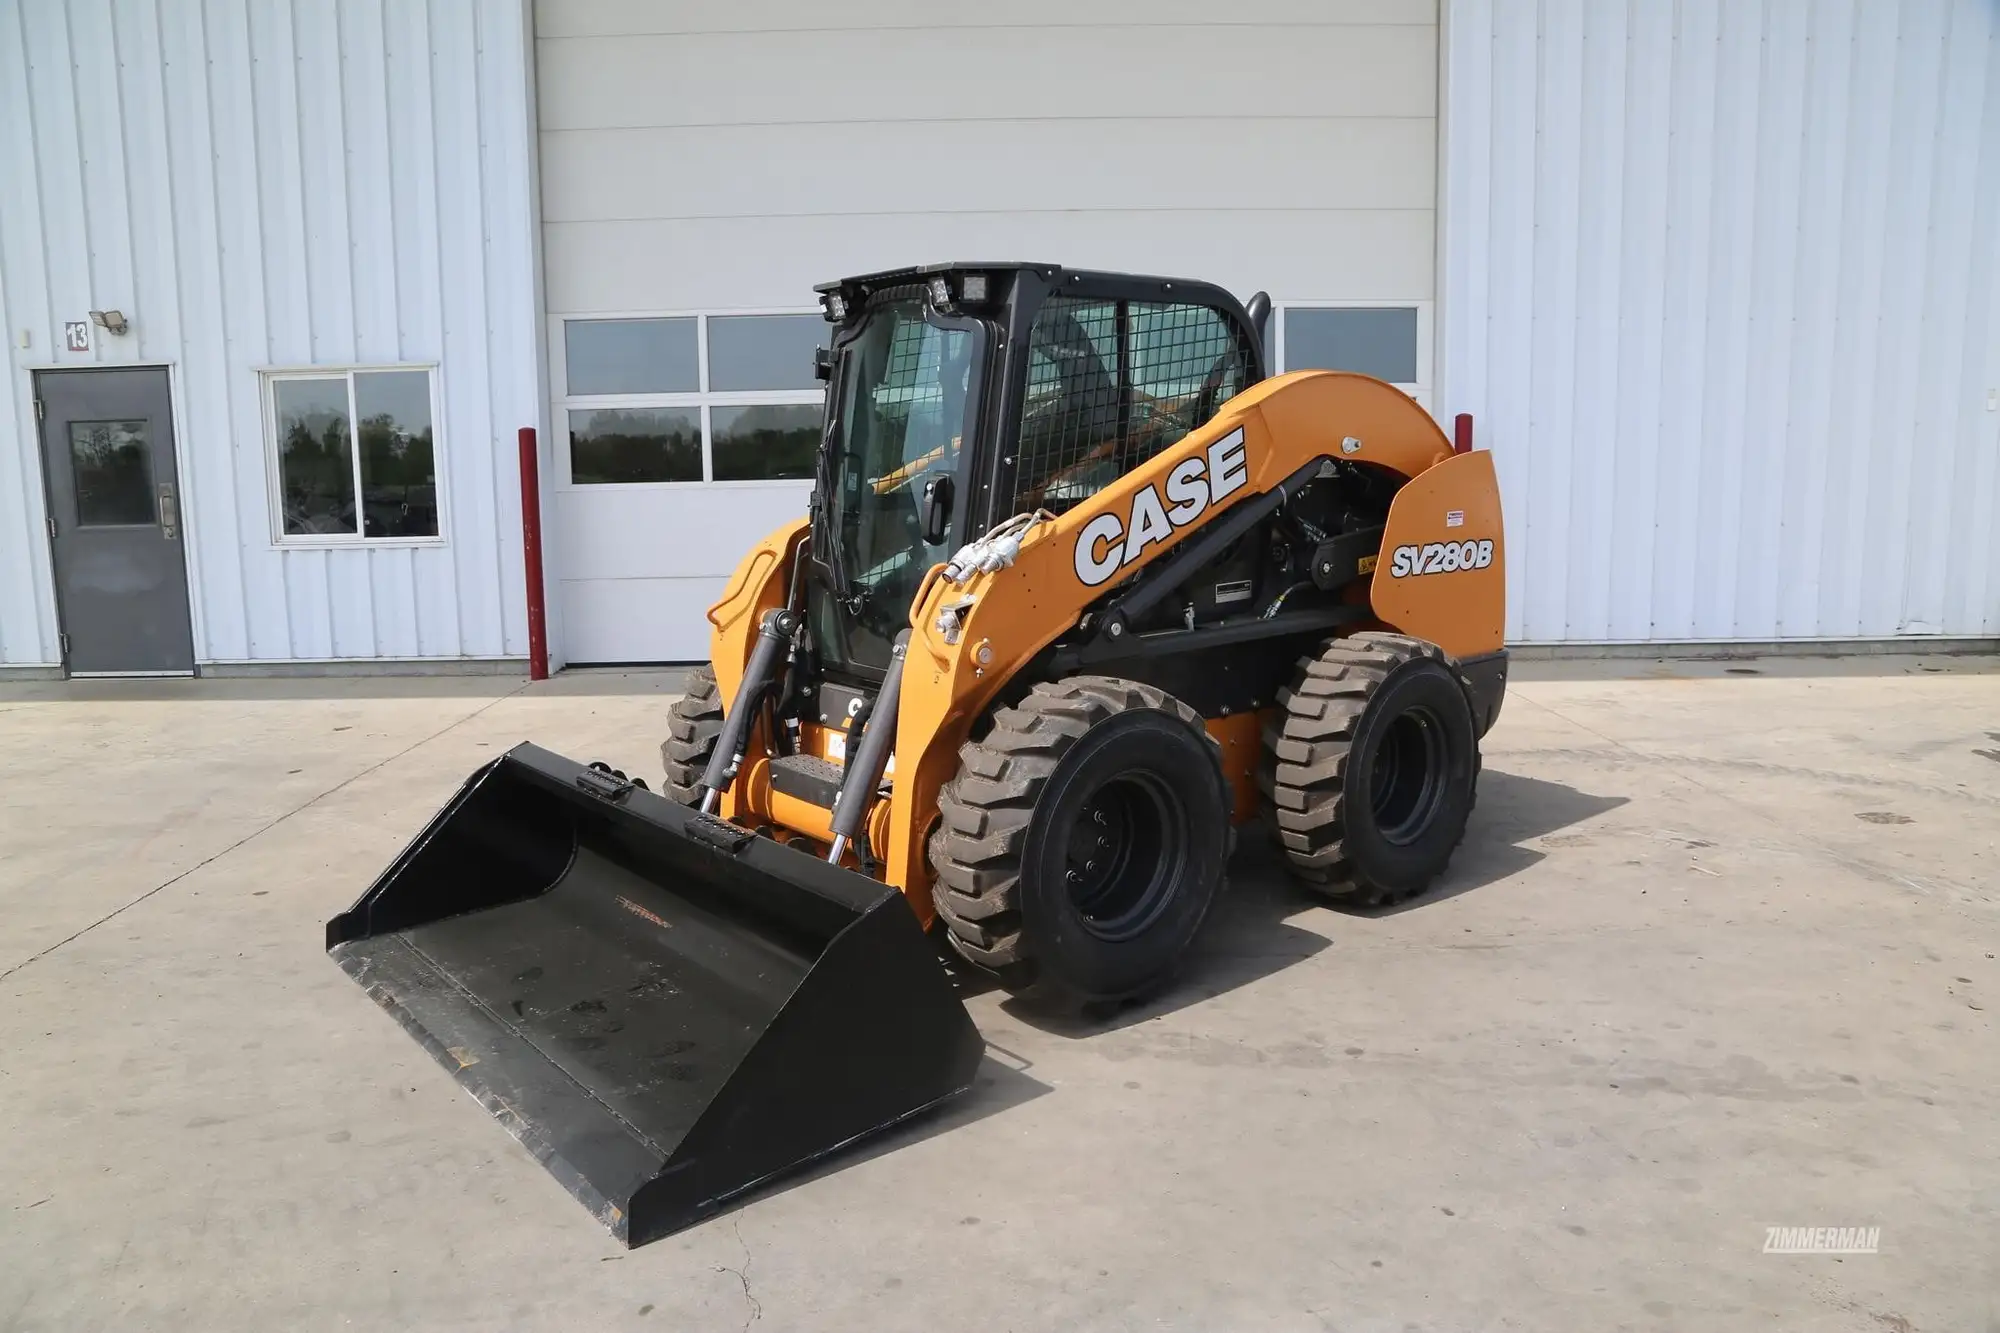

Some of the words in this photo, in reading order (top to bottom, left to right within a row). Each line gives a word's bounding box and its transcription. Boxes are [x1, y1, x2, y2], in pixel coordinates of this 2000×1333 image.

[67, 323, 88, 348] 13
[1074, 425, 1247, 587] CASE
[1390, 538, 1494, 578] SV280B
